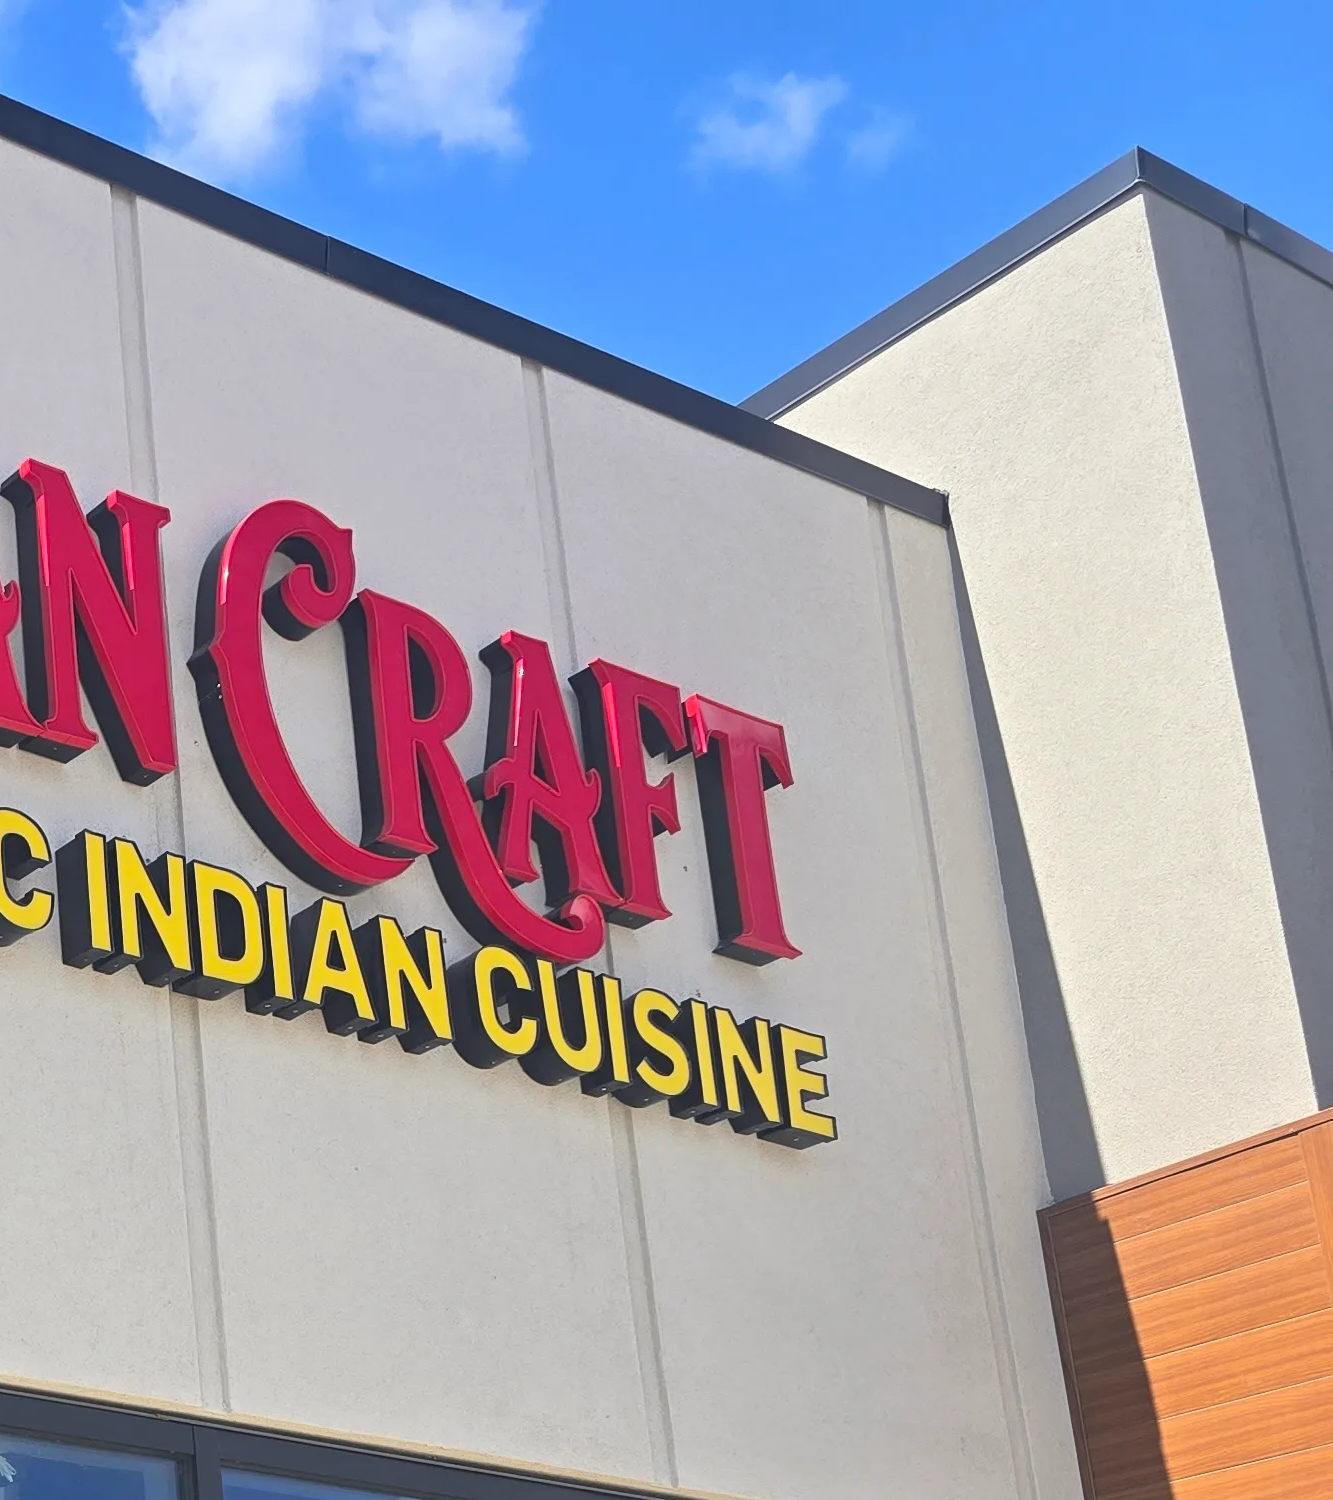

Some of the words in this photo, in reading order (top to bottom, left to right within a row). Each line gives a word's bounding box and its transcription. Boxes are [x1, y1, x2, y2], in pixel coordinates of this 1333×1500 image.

[193, 498, 803, 964] CRAFT
[75, 830, 455, 1048] INDIAN
[469, 945, 837, 1142] CUISINE
